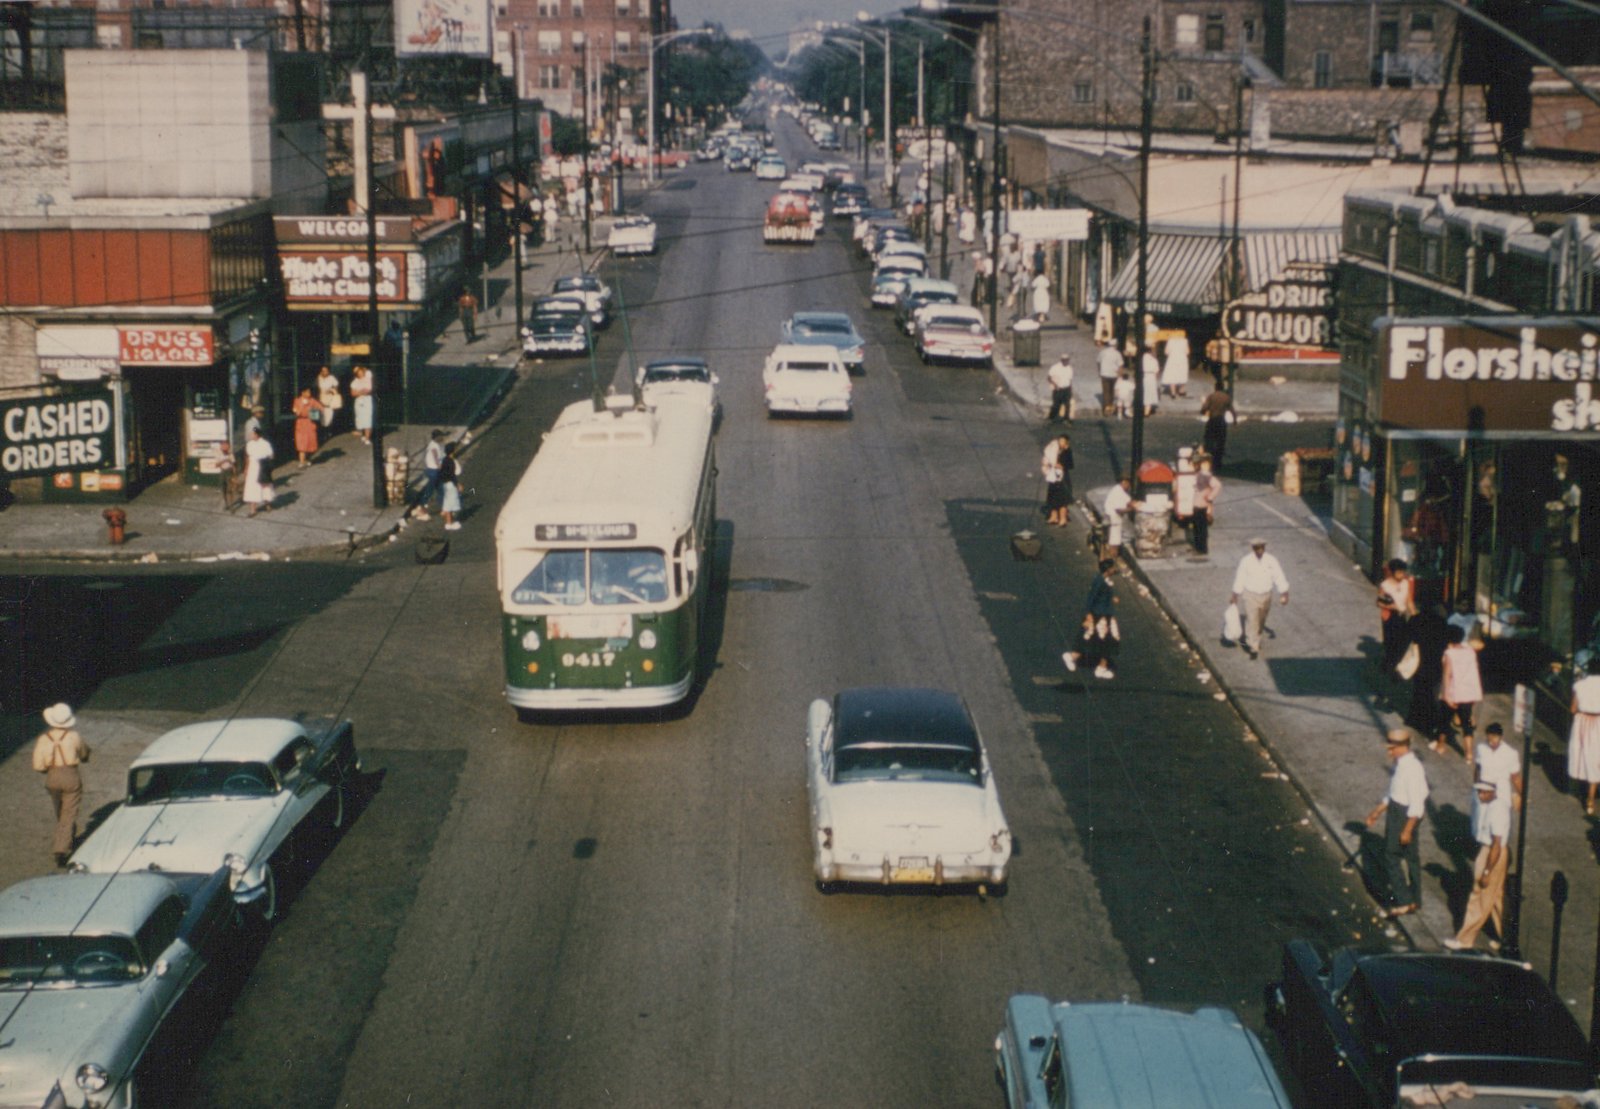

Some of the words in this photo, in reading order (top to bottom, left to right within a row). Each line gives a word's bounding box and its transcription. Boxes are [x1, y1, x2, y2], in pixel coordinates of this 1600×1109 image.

[280, 255, 339, 282] Hyde
[341, 255, 397, 280] Pak
[289, 279, 333, 296] Bible
[334, 279, 397, 298] Chuch
[123, 347, 211, 362] LIQUORS
[126, 331, 205, 347] DRUGS
[1389, 326, 1600, 381] Florshei
[4, 400, 110, 442] CASHED
[1551, 382, 1600, 431] sh
[2, 437, 102, 472] ORDERS
